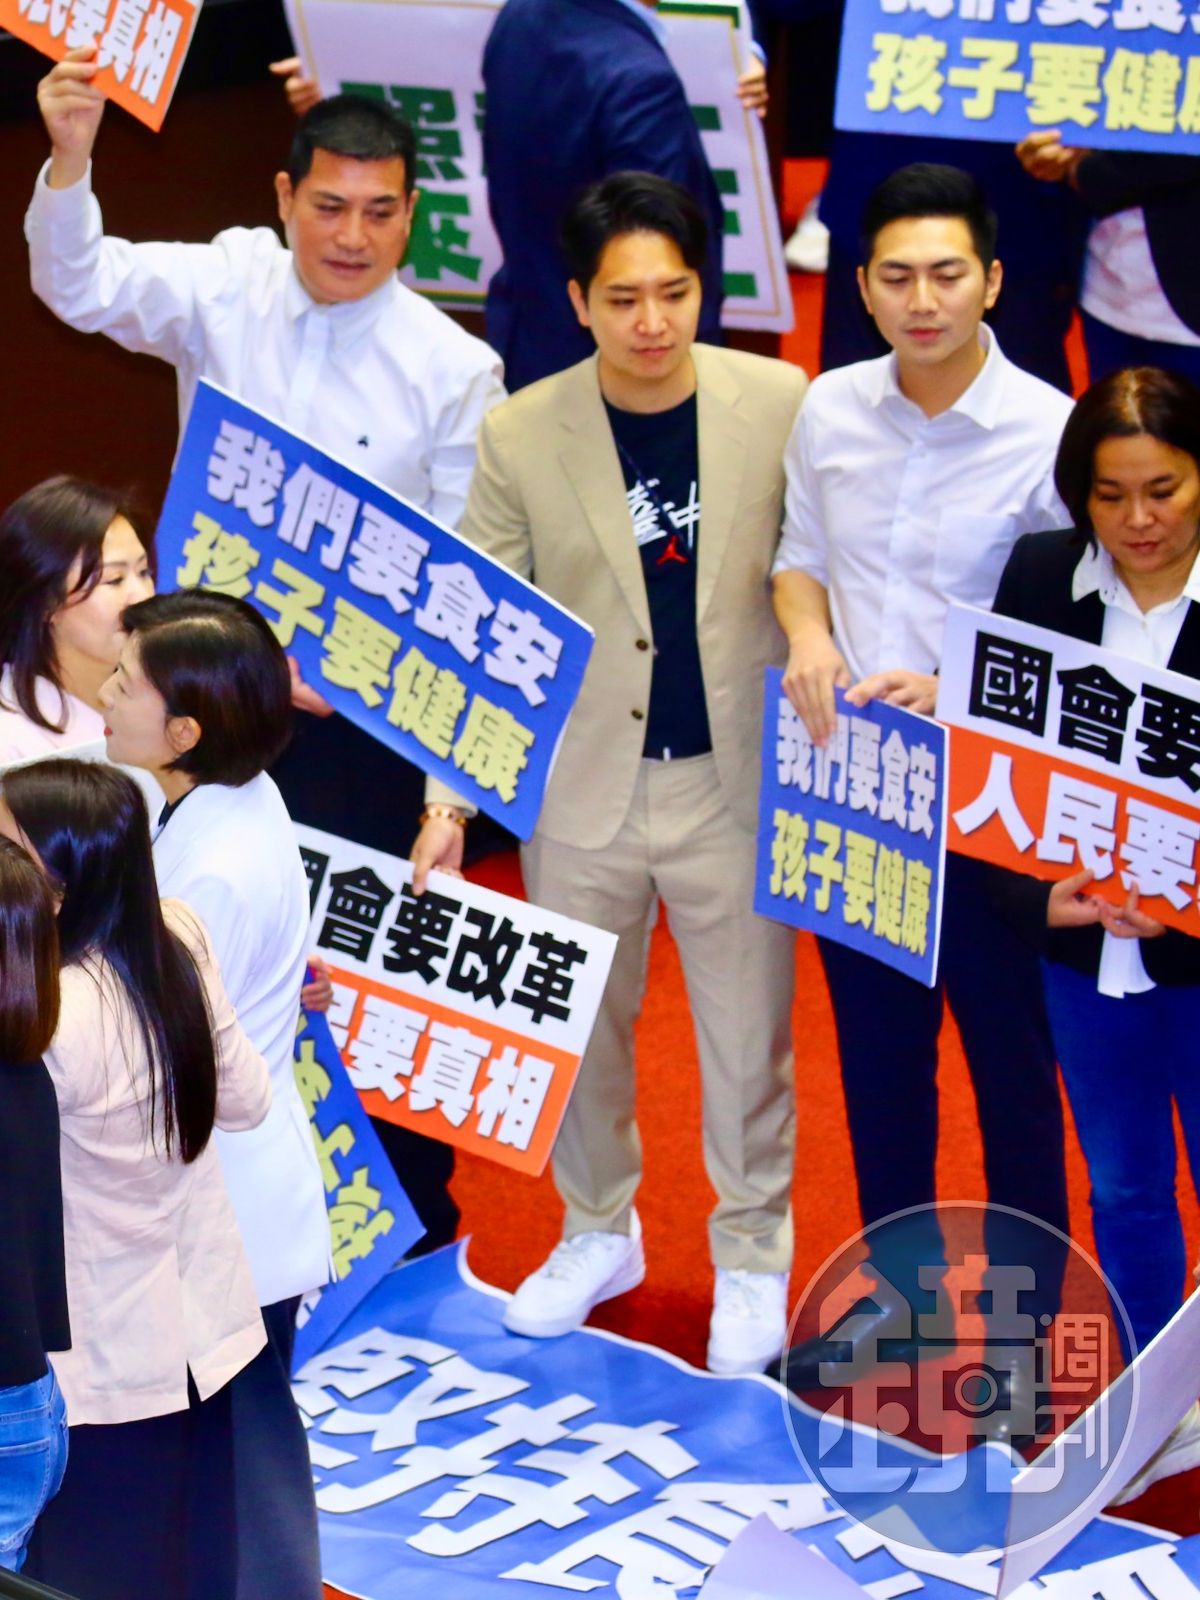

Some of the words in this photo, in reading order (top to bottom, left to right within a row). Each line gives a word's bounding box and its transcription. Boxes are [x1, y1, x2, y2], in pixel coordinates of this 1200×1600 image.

[206, 419, 564, 708] 我們要食安
[176, 511, 535, 804] 孩子要健康
[968, 629, 1200, 794] 國會要
[775, 697, 937, 841] 我們要食安
[952, 751, 1200, 912] 人民要
[768, 807, 933, 958] 孩子要健康
